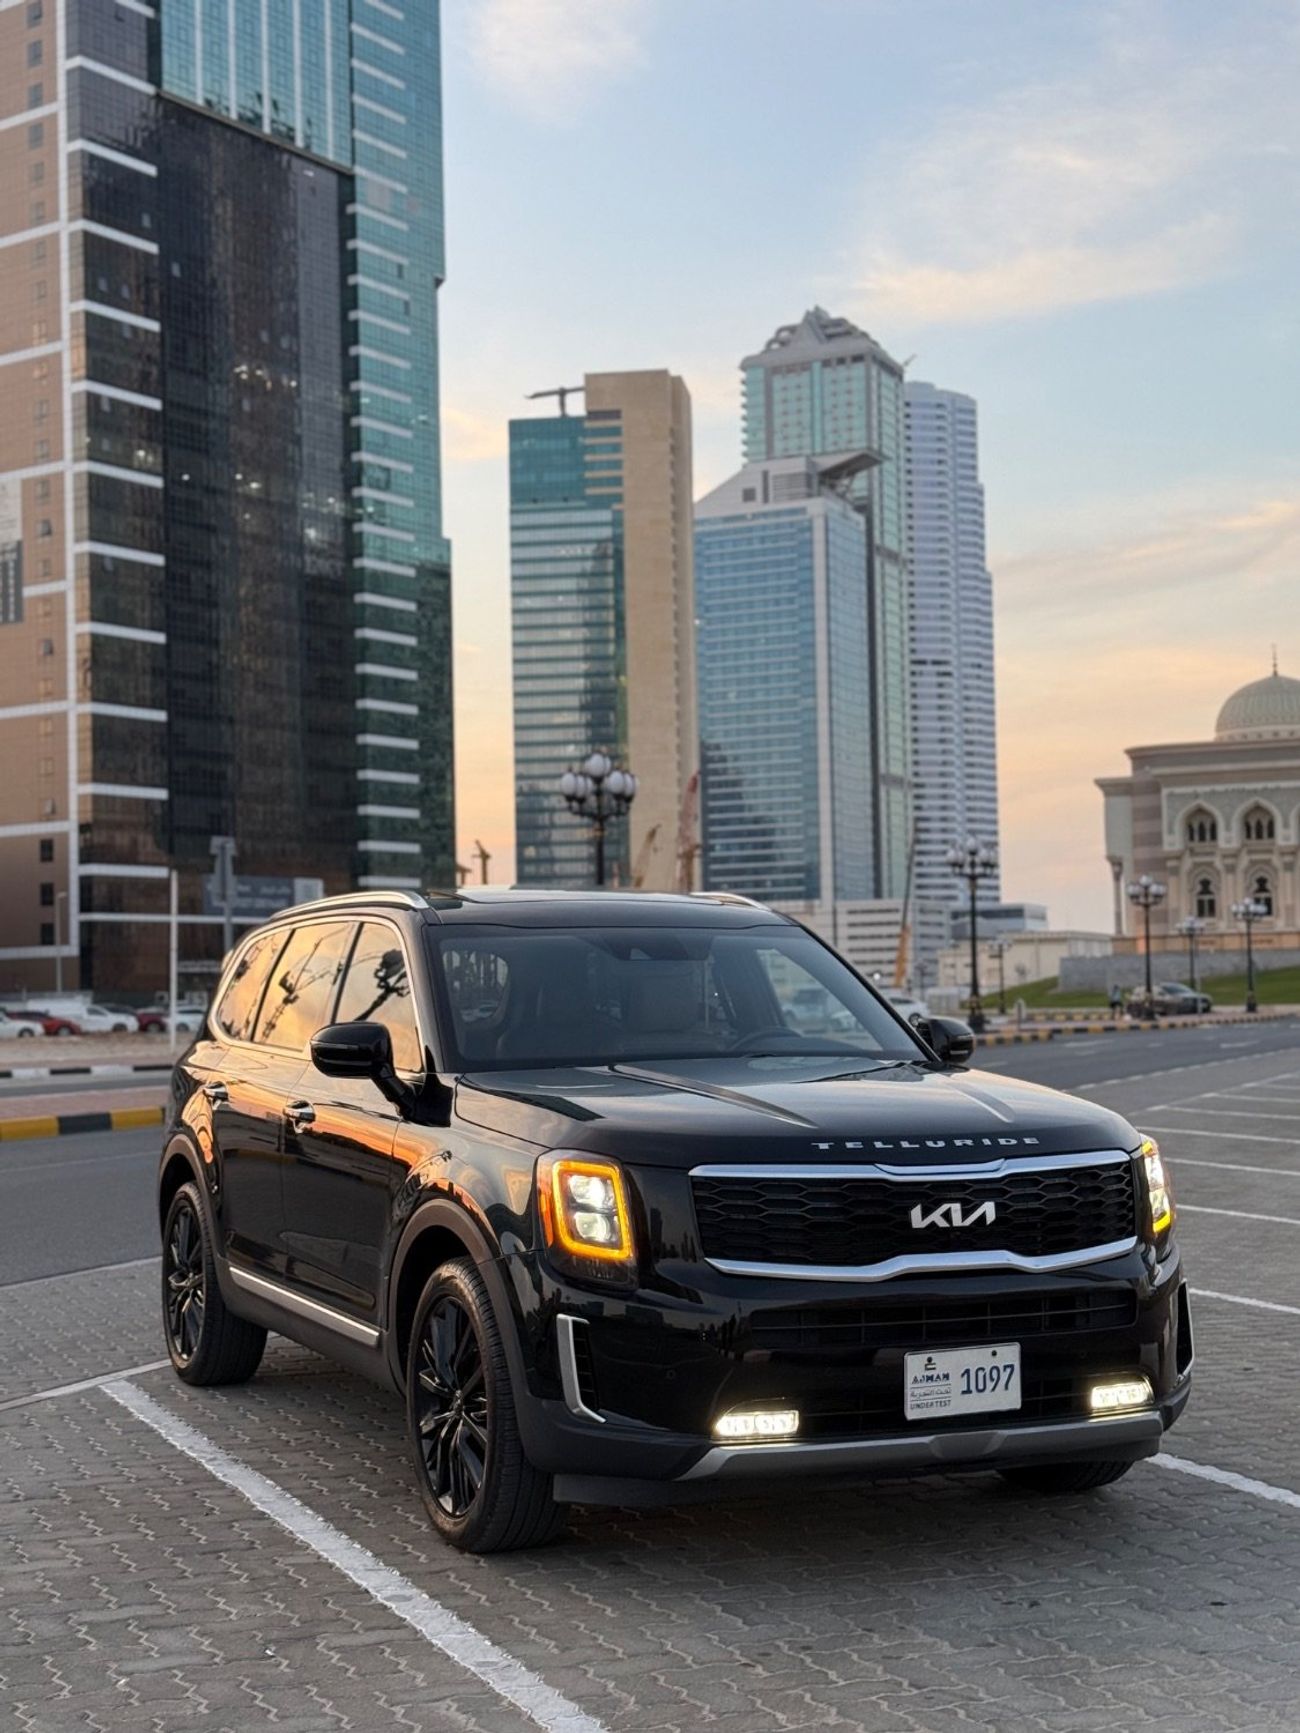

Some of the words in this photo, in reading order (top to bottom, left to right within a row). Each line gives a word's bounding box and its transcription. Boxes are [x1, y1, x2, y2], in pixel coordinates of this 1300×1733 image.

[811, 1137, 1040, 1150] TELLURIDE
[910, 1201, 996, 1229] KIA
[912, 1372, 950, 1385] AJMAN
[961, 1363, 1015, 1395] 1097
